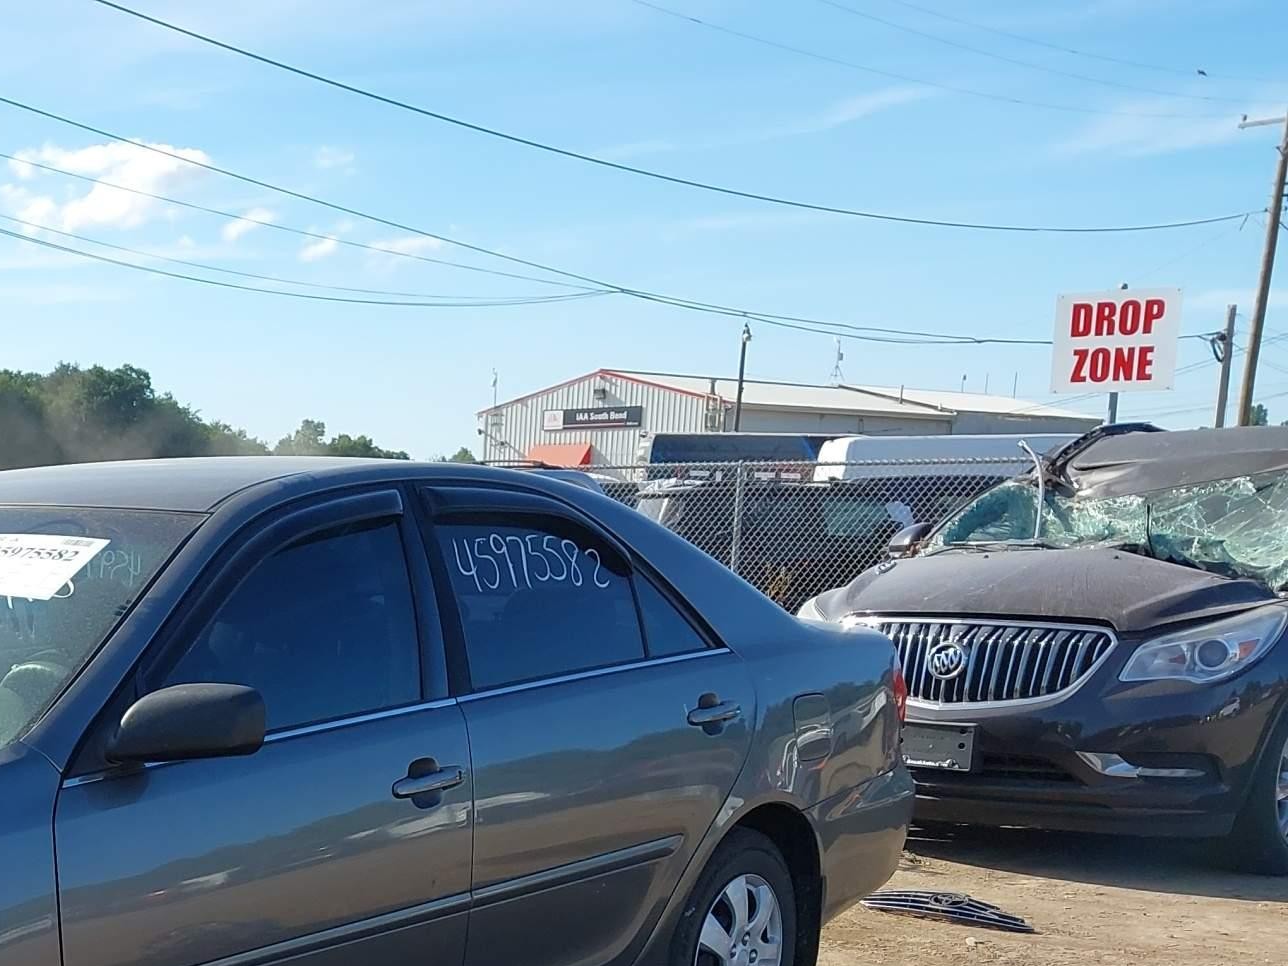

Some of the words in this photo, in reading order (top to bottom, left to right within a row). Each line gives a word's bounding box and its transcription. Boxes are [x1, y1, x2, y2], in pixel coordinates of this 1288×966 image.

[1070, 299, 1165, 337] DROP
[1070, 346, 1155, 383] ZONE
[452, 533, 611, 593] 45975582
